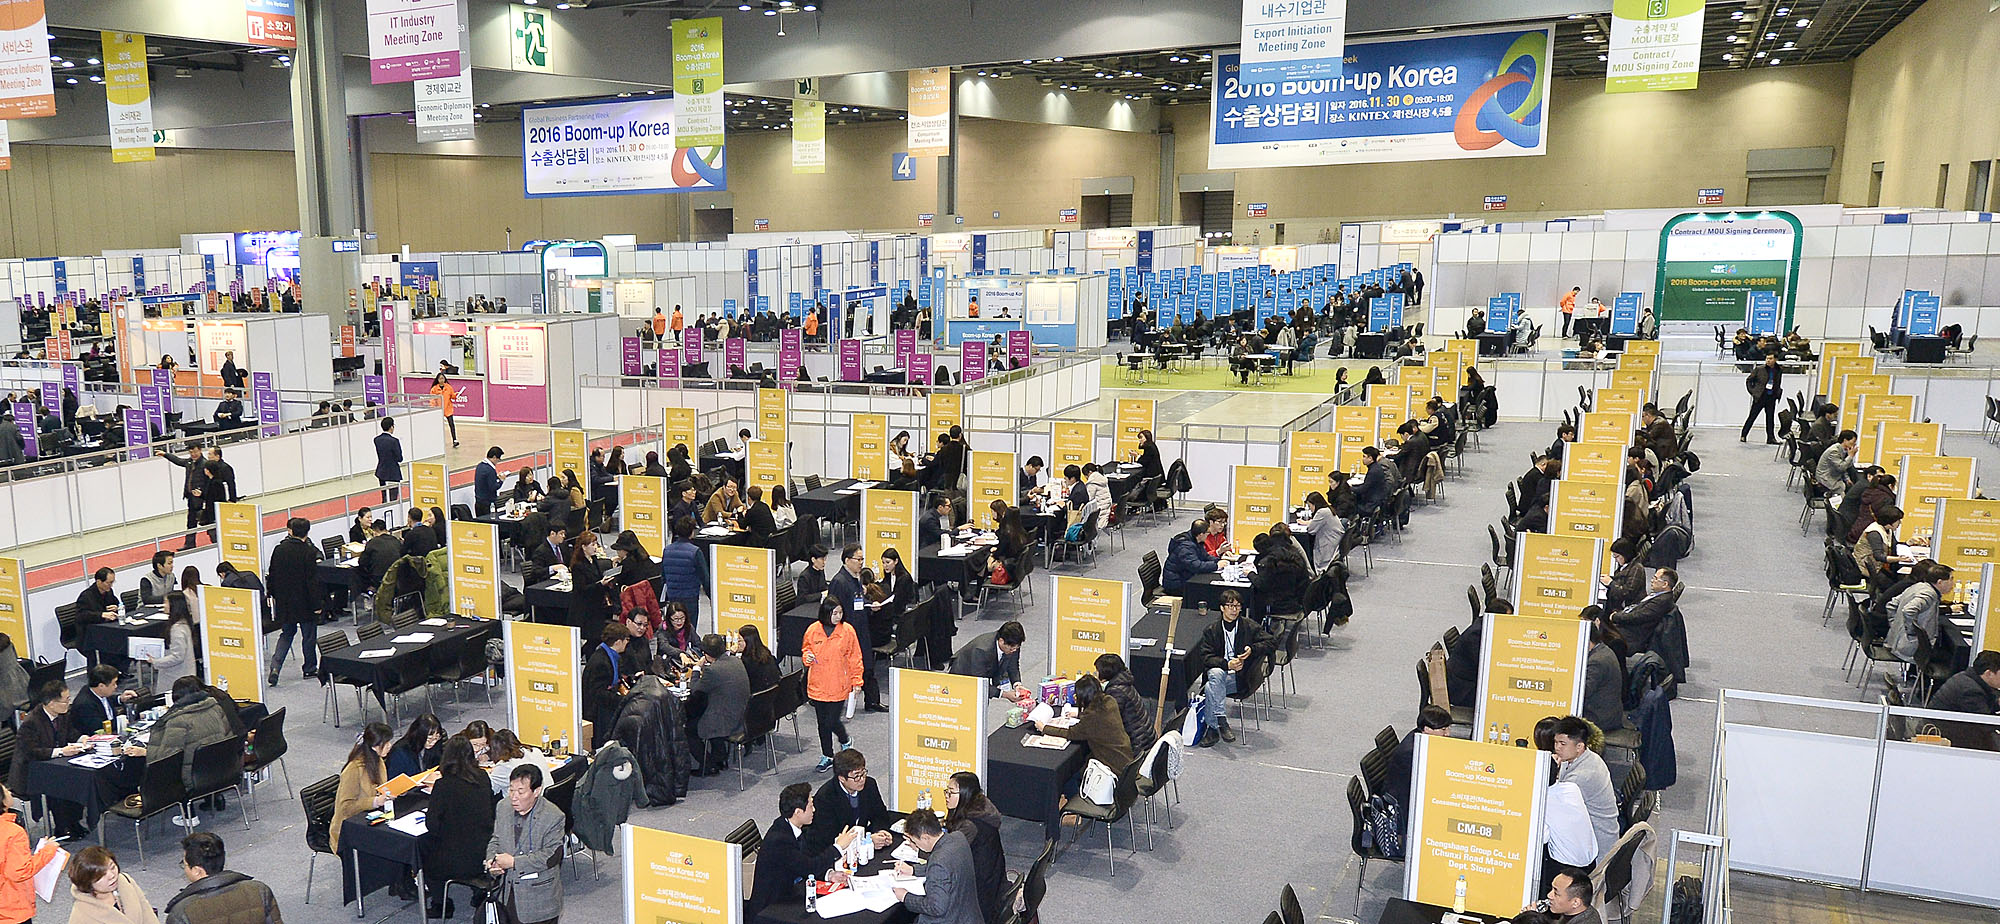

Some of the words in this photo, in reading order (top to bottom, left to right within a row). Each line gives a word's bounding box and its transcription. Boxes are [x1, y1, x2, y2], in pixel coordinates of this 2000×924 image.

[1262, 0, 1326, 18] 내수기업관
[1654, 1, 1662, 14] 3
[266, 20, 292, 32] 소화기
[390, 17, 398, 28] IT
[400, 16, 435, 27] Industry
[384, 32, 420, 46] Meeting
[422, 30, 443, 42] Zone
[1254, 28, 1285, 40] Export
[1288, 24, 1332, 36] Initiation
[1258, 42, 1298, 52] Meeting
[1301, 40, 1326, 50] Zone
[1632, 36, 1652, 44] MOU
[1633, 50, 1670, 60] Contract
[19, 64, 44, 74] Industry
[1612, 64, 1634, 72] MOU
[1636, 61, 1670, 72] Signing
[1672, 60, 1694, 69] Zone
[1388, 65, 1458, 88] Korea
[0, 79, 25, 90] Meeting
[26, 78, 42, 88] Zone
[426, 82, 462, 96] 경제외교관
[696, 82, 700, 91] 2
[417, 104, 442, 112] Economic
[444, 102, 472, 111] Diplomacy
[1330, 100, 1346, 110] 일자
[1386, 96, 1400, 106] 30
[450, 112, 462, 120] Zone
[1222, 101, 1320, 128] 수출상담회
[1329, 112, 1346, 124] 장소
[1348, 111, 1390, 122] KINTEX
[530, 126, 560, 144] 2016
[565, 124, 624, 142] Boom-up
[629, 120, 670, 138] Korea
[629, 144, 637, 152] 30
[531, 148, 589, 167] 수출상담회
[606, 155, 632, 164] KINTEX
[897, 156, 910, 177] 4
[1726, 228, 1751, 236] Signing
[1752, 227, 1786, 236] Ceremony
[1688, 278, 1720, 287] Boom-up
[1721, 278, 1742, 286] Korea
[1574, 523, 1595, 532] CM-25
[1963, 548, 1988, 556] CM-26
[1544, 588, 1567, 598] CM-18
[1078, 631, 1100, 640] CM-12
[1516, 679, 1545, 690] CM-13
[1492, 693, 1506, 702] First
[1507, 694, 1526, 703] Wave
[1526, 697, 1556, 708] Company
[924, 738, 950, 750] CM-07
[1446, 769, 1474, 780] Boom-up
[1476, 774, 1495, 783] Korea
[1496, 777, 1513, 786] 2016
[1432, 798, 1461, 808] Consumer
[1461, 802, 1480, 810] Goods
[1481, 805, 1506, 816] Meeting
[1507, 809, 1522, 817] Zone
[1457, 822, 1493, 838] CM-08
[1425, 837, 1469, 853] Chengshang
[1470, 844, 1492, 857] Group
[1508, 851, 1521, 861] Ltd.
[1432, 847, 1462, 860] (Chunxi
[1463, 853, 1484, 864] Road
[1485, 857, 1513, 869] Maoye
[1448, 860, 1468, 871] Dept.
[1470, 863, 1495, 875] Store)
